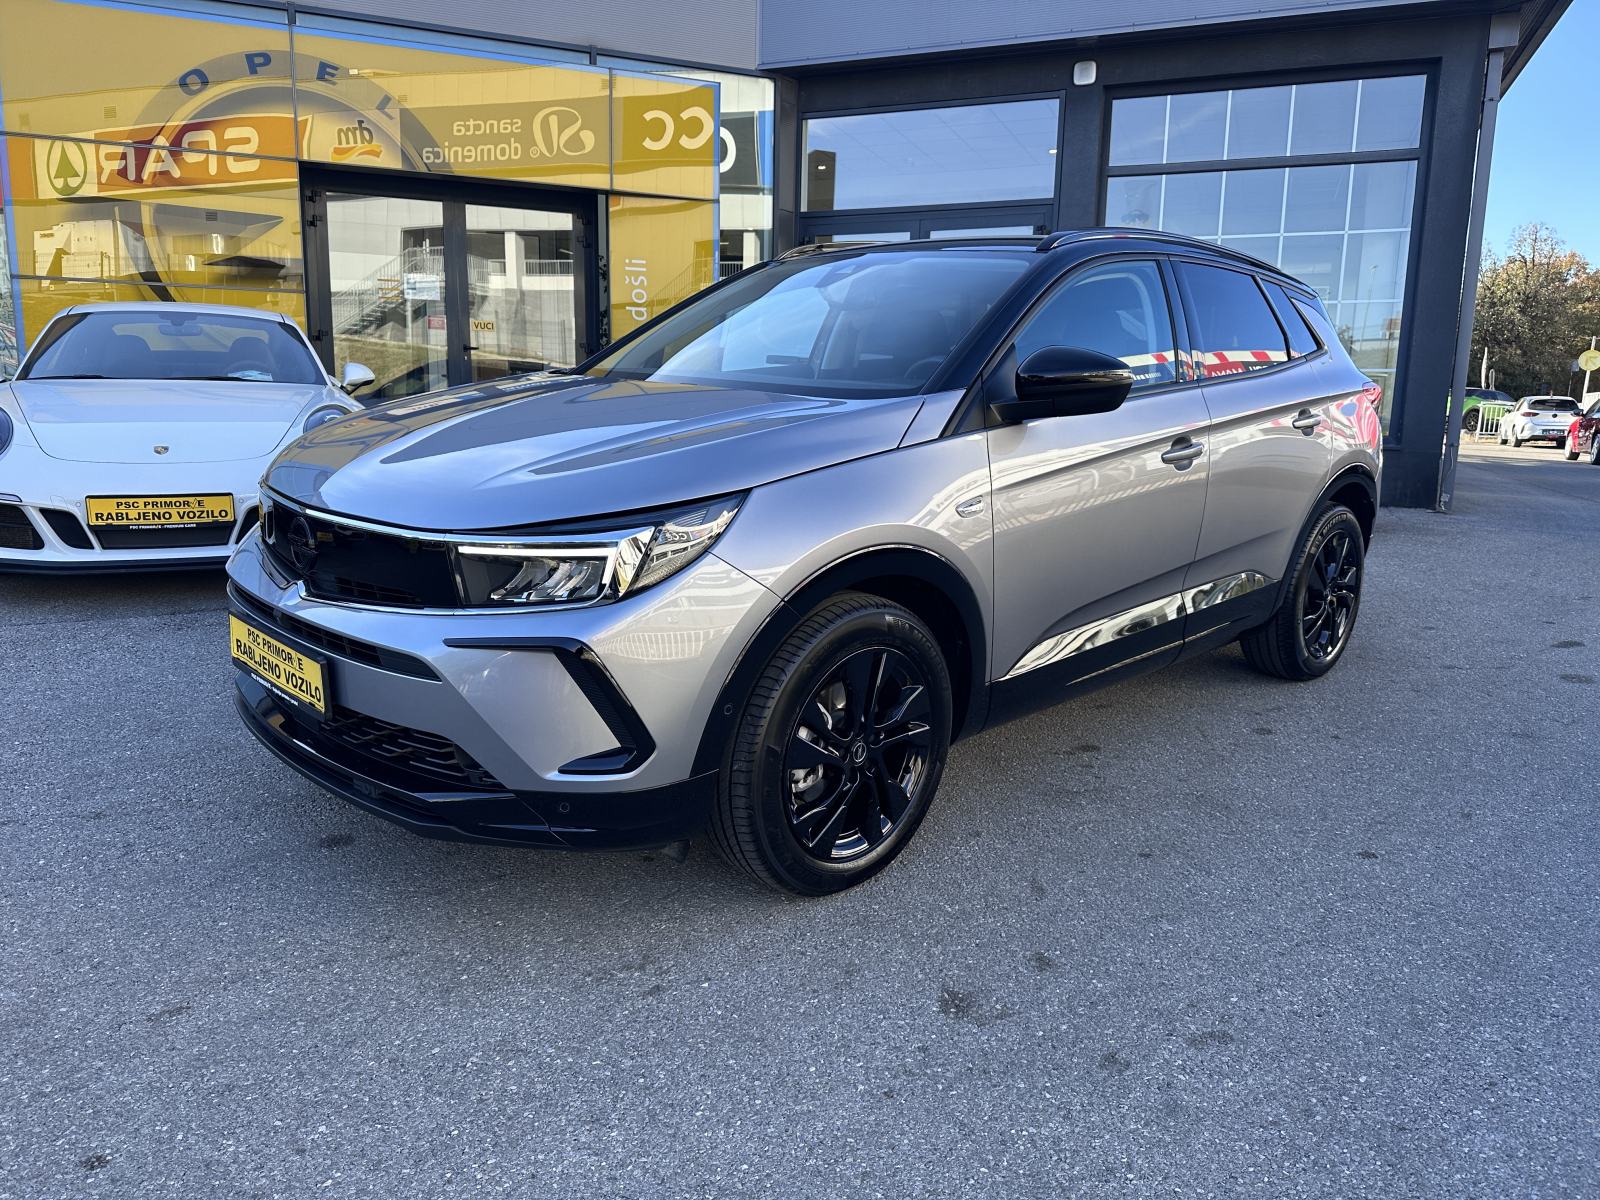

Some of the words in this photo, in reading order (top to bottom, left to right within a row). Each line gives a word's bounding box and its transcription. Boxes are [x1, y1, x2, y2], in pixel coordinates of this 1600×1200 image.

[178, 52, 395, 121] OPEL
[625, 258, 647, 321] došli
[473, 321, 494, 330] VUCI
[115, 501, 139, 509] PSC
[94, 511, 172, 522] RABLJENO
[177, 509, 228, 520] VOZILO
[247, 628, 261, 646] PSC
[236, 638, 281, 679] RABLJENO
[284, 668, 321, 702] VOZILO
